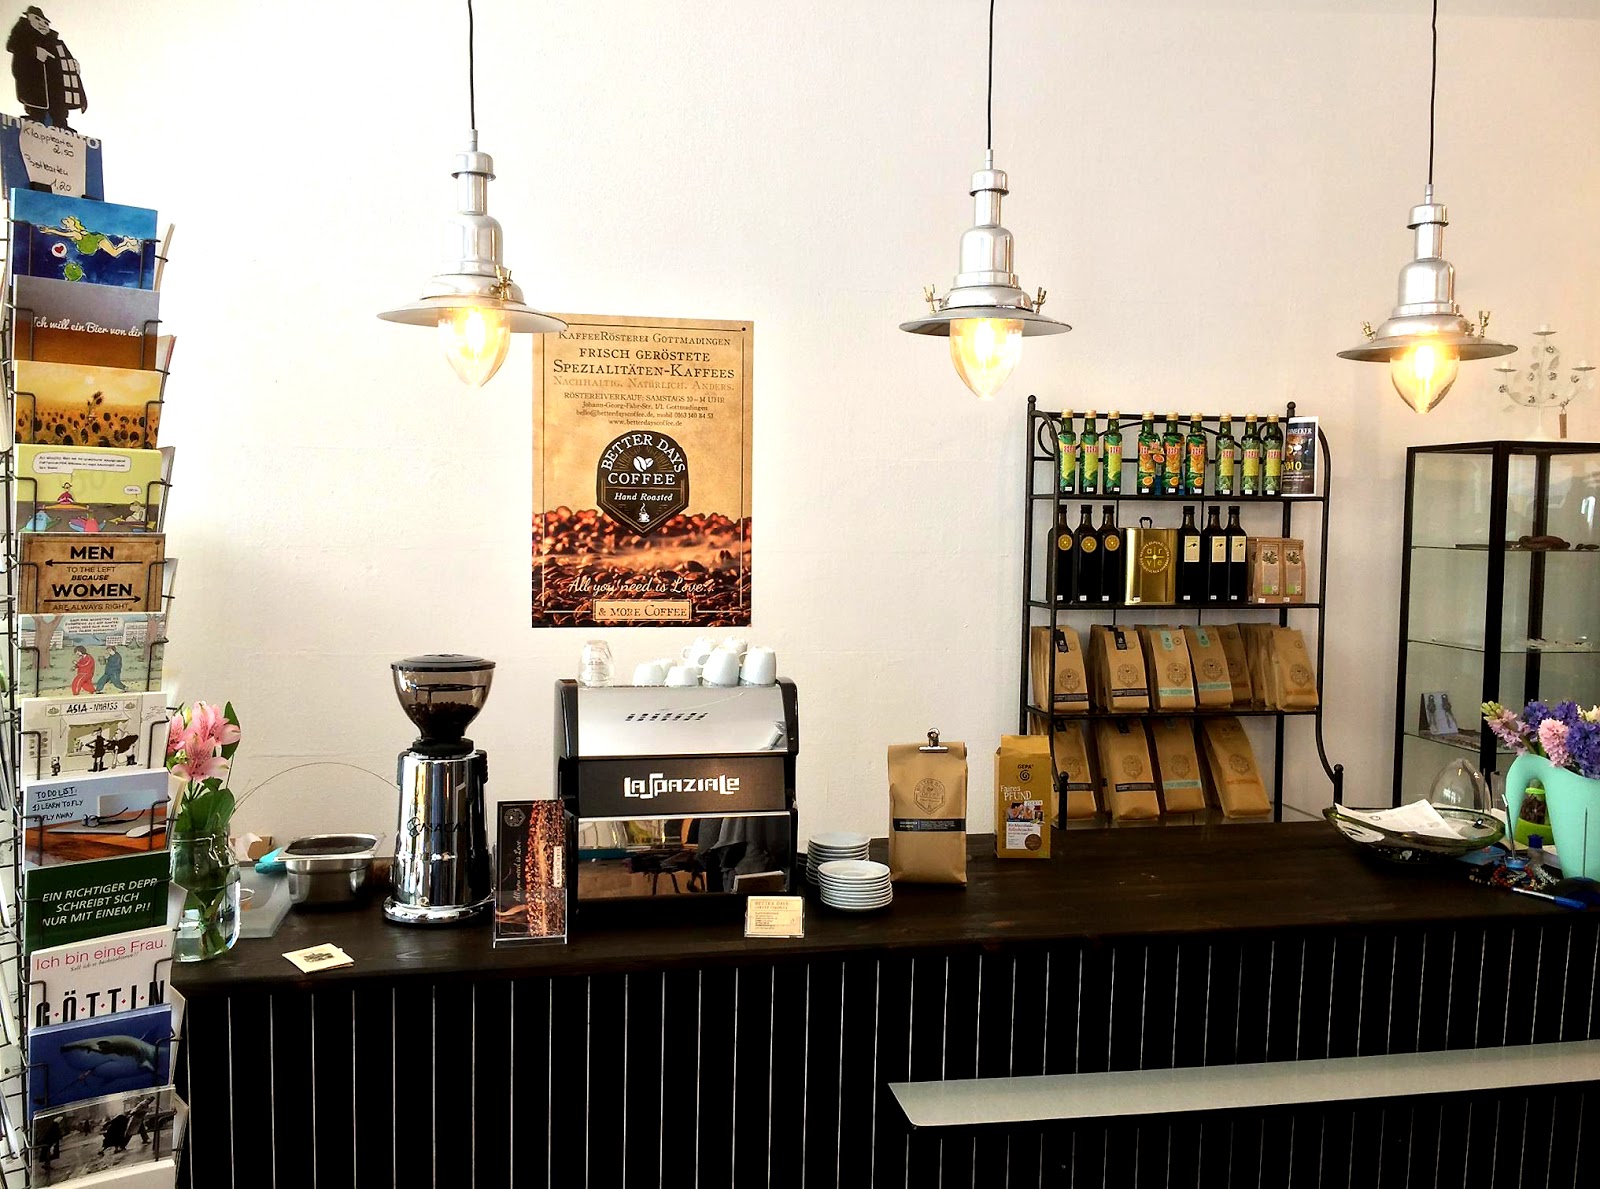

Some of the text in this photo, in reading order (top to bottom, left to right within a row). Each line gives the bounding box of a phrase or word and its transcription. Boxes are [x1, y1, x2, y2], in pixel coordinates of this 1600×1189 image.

[50, 318, 70, 331] will
[70, 323, 86, 332] ein
[86, 322, 108, 334] Bier
[110, 328, 126, 336] von
[652, 333, 731, 346] GOTTMADINGEN
[579, 348, 710, 362] FRISCH GERÖSTETE
[553, 359, 735, 378] SPEZIALITÄTEN-KAFFEES
[601, 434, 686, 473] BETTER DAYS
[608, 472, 676, 485] COFFEE
[614, 492, 674, 501] Hand Roasted
[70, 546, 114, 560] MEN
[52, 584, 132, 598] WOMEN
[568, 576, 591, 592] All
[593, 582, 616, 596] you
[620, 576, 654, 593] need
[656, 580, 667, 593] is
[598, 605, 687, 617] & MORE COFFEE
[66, 703, 88, 714] ASIA
[36, 790, 46, 799] TO
[48, 788, 58, 797] DO
[1004, 790, 1032, 801] PFUND
[40, 802, 61, 810] LEARN
[62, 800, 71, 808] TO
[71, 799, 84, 807] FLY
[56, 812, 74, 820] AWAY
[42, 892, 62, 902] EIN
[65, 882, 125, 900] RICHTIGER
[56, 892, 140, 912] SCHREIBT SICH
[42, 915, 67, 927] NUR
[70, 911, 92, 924] MIT
[95, 906, 132, 919] EINEM
[36, 938, 168, 971] Ich bin eine Frau.
